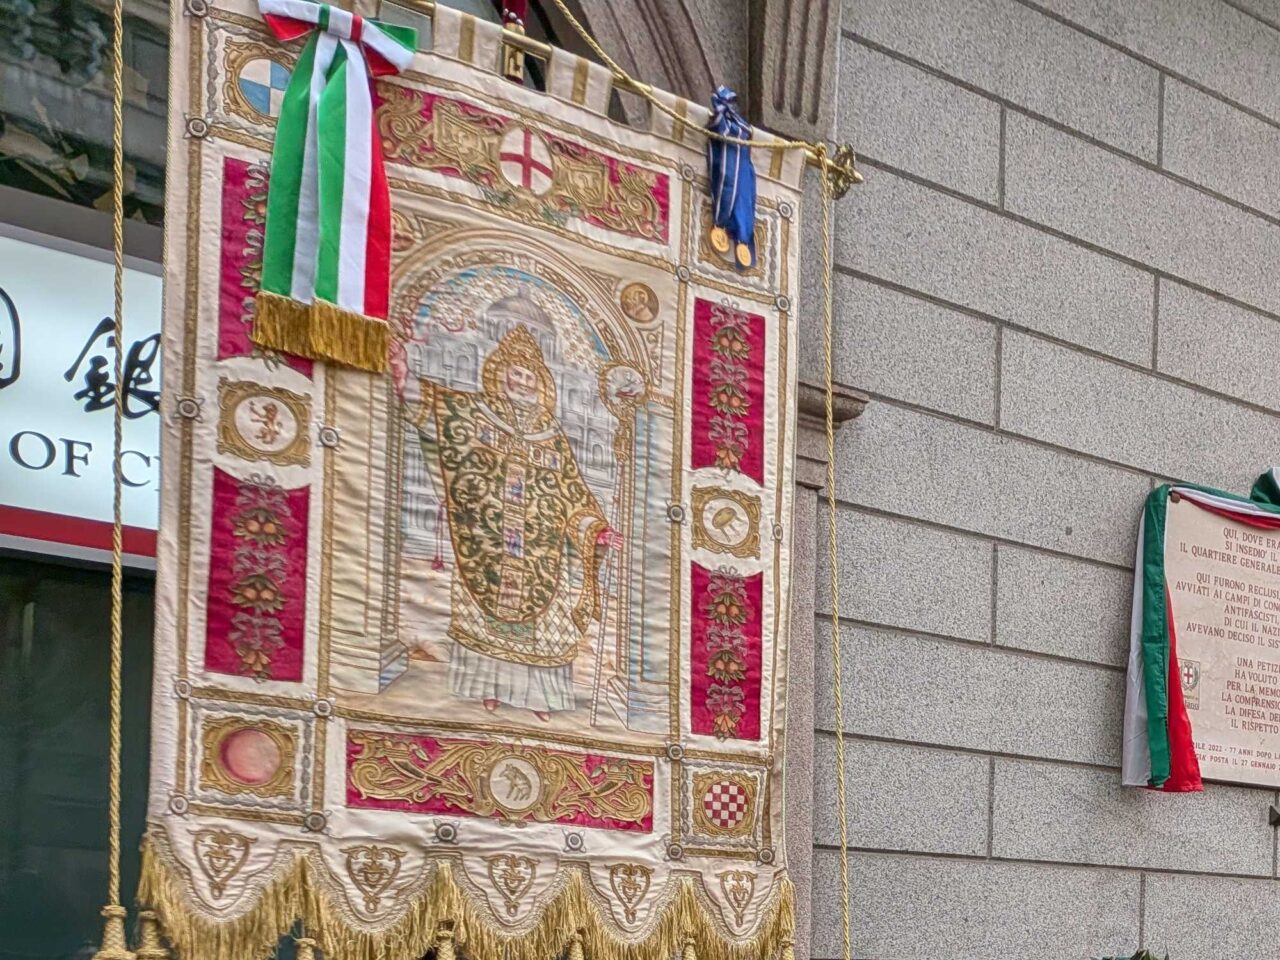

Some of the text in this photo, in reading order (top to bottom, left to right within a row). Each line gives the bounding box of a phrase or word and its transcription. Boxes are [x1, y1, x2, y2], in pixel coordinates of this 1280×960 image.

[9, 430, 93, 477] OF
[1223, 527, 1239, 541] QUI,
[1242, 532, 1263, 546] DOVE
[1180, 542, 1188, 553] IL
[1191, 545, 1237, 565] QUARTIERE
[1240, 557, 1280, 576] GENERALE
[1224, 541, 1233, 551] SI
[1270, 552, 1277, 562] IL
[1175, 581, 1210, 597] AVVIATI
[1213, 589, 1222, 599] AI
[1224, 592, 1250, 605] CAMPI
[1253, 598, 1261, 608] DI
[1196, 572, 1211, 585] QUI
[1213, 576, 1246, 592] FURONO
[1248, 584, 1280, 600] RECLUSI,
[1224, 604, 1280, 625] ANTIFASCISTI,
[1186, 622, 1225, 638] AVEVANO
[1228, 630, 1255, 644] DECISO
[1257, 636, 1265, 646] IL
[1224, 617, 1232, 627] DI
[1234, 619, 1248, 630] CUI
[1251, 623, 1259, 633] IL
[1236, 656, 1254, 669] UNA
[1226, 680, 1241, 691] PER
[1244, 683, 1255, 693] LA
[1234, 669, 1246, 680] HA
[1248, 671, 1278, 685] VOLUTO
[1221, 692, 1232, 702] LA
[1225, 705, 1236, 716] LA
[1239, 707, 1266, 720] DIFESA
[1231, 719, 1238, 728] IL
[1241, 720, 1279, 734] RISPETTO
